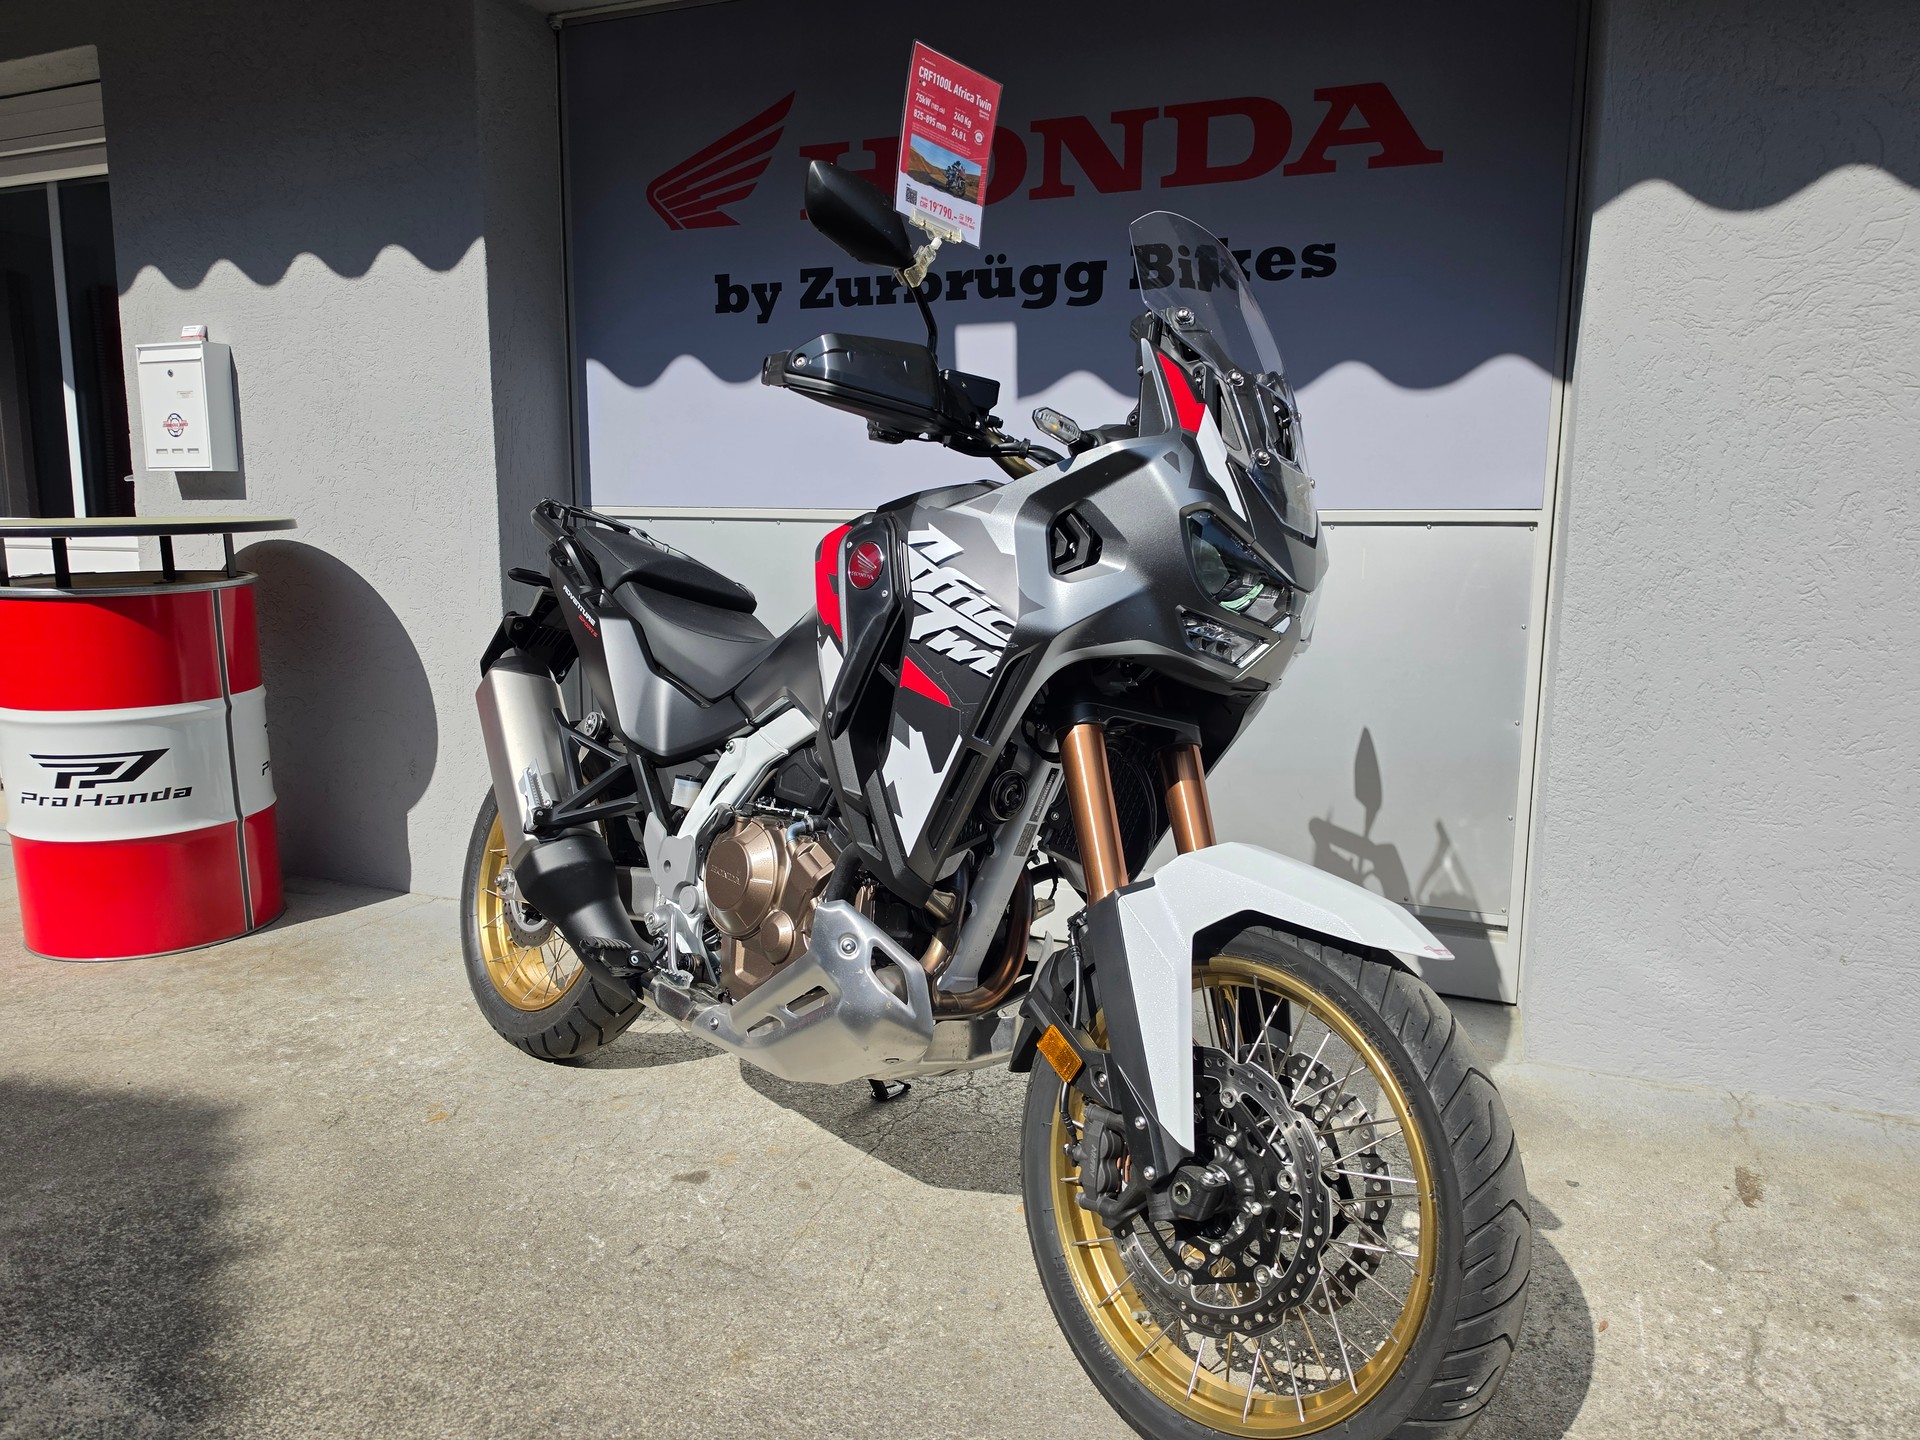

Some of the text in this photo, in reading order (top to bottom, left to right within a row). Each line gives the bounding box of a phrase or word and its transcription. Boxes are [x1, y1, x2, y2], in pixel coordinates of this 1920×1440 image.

[918, 65, 952, 92] CRF1100L
[953, 83, 975, 103] Africa
[976, 95, 992, 112] Twin
[935, 121, 947, 132] mm
[953, 111, 964, 124] 240
[963, 116, 972, 129] Kg
[714, 273, 781, 323] by
[1130, 238, 1336, 291] Bikes
[562, 584, 596, 627] ADVENTURE
[578, 614, 599, 638] SPORTS
[710, 864, 742, 886] HONDA
